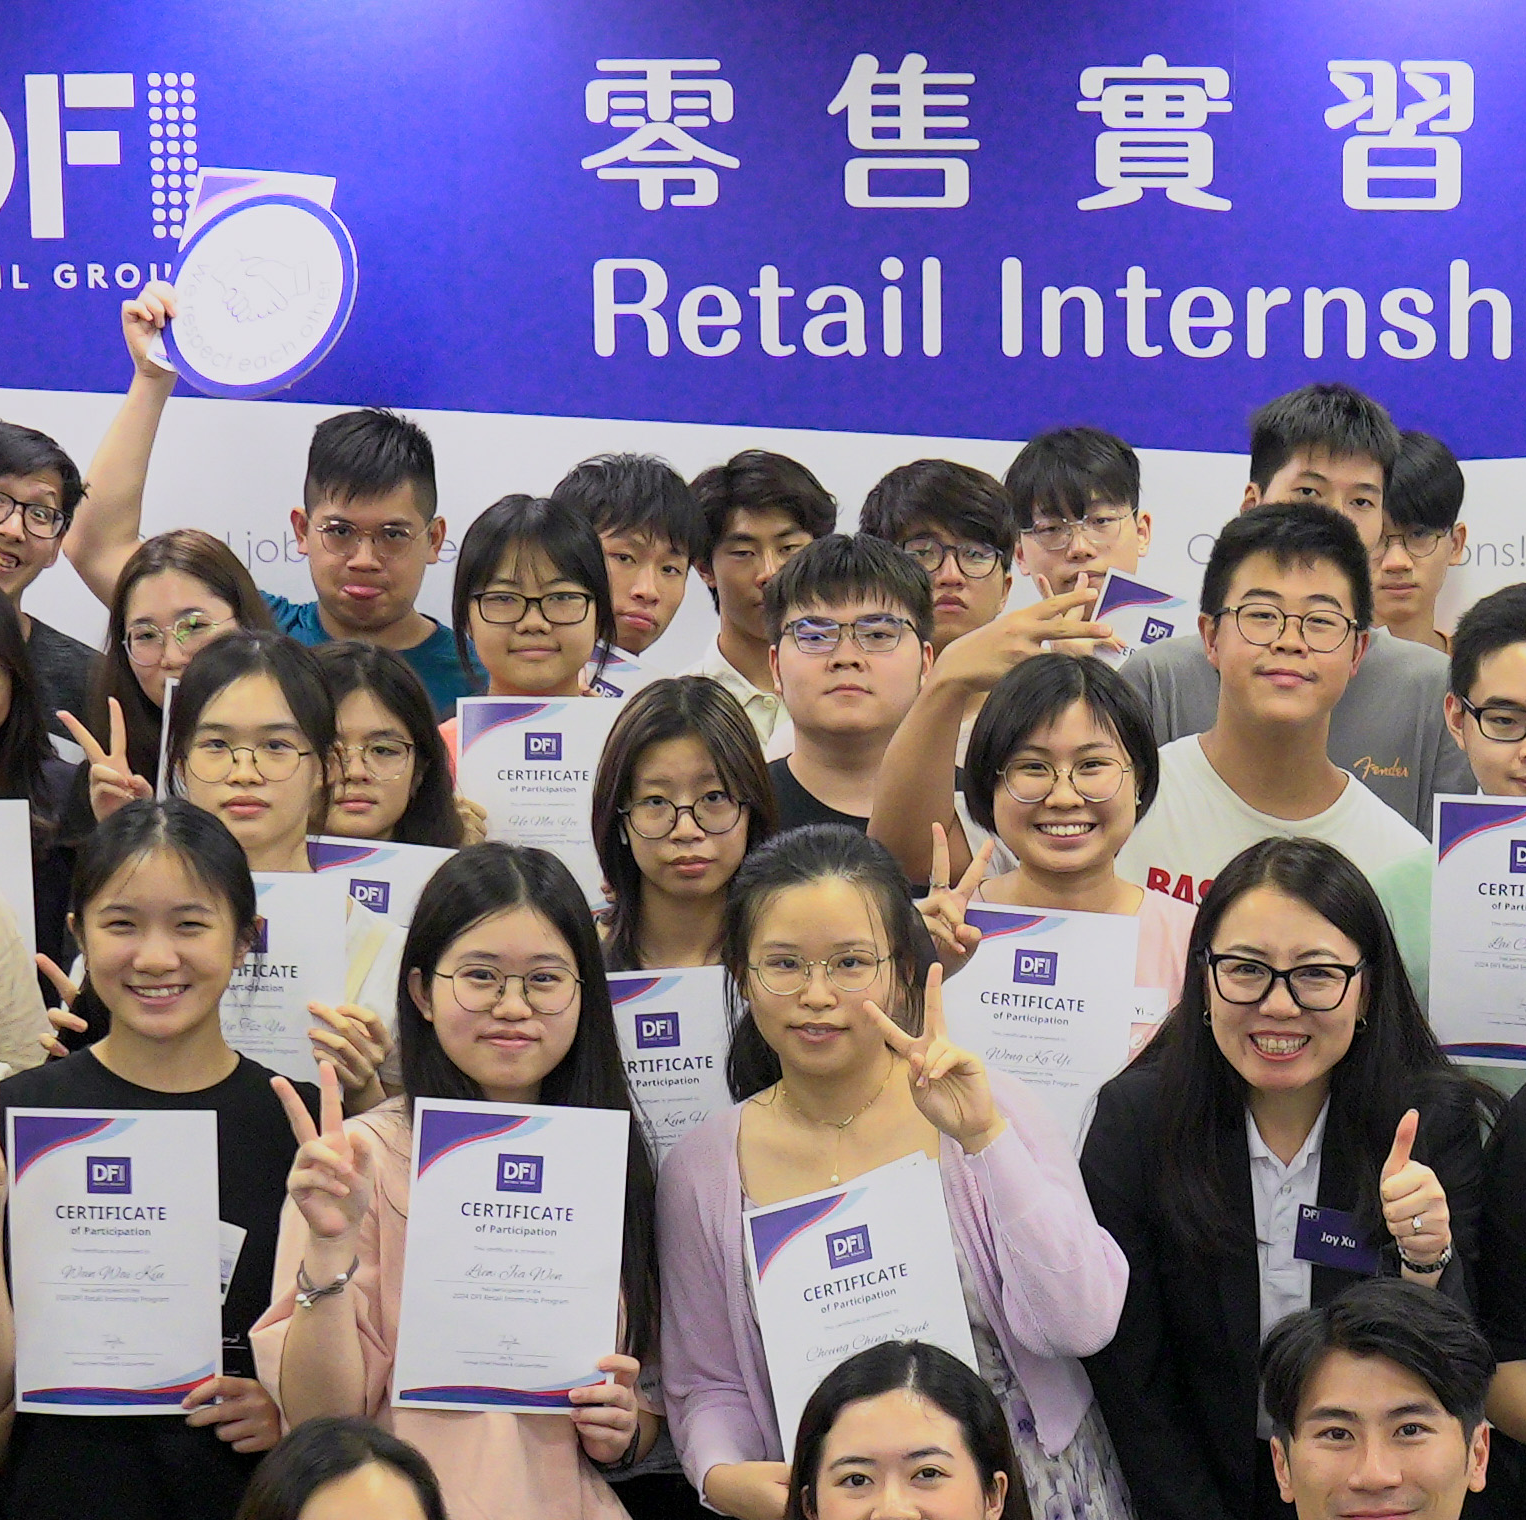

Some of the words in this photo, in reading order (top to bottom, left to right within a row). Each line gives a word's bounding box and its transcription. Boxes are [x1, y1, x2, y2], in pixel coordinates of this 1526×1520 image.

[53, 262, 172, 292] GROU
[592, 256, 942, 359] Retail
[530, 738, 557, 752] DFI
[497, 769, 589, 781] CERTIFICATE
[1354, 756, 1409, 779] Fender
[354, 885, 384, 902] DFI
[1491, 902, 1501, 910] of
[231, 963, 299, 978] IFICATE
[1020, 956, 1051, 974] DFI
[980, 991, 1085, 1012] CERTIFICATE
[993, 1012, 1003, 1020] of
[1006, 1013, 1069, 1025] Participation
[642, 1019, 674, 1037] DFI
[623, 1056, 714, 1074] RTIFICATE
[636, 1077, 700, 1089] Participation
[91, 1164, 125, 1183] DFI
[503, 1162, 537, 1180] DFI
[55, 1205, 167, 1220] CERTIFICATE
[461, 1202, 574, 1221] CERTIFICATE
[71, 1227, 81, 1235] of
[84, 1227, 152, 1237] Participation
[475, 1224, 486, 1233] of
[490, 1225, 557, 1237] Participation
[833, 1232, 865, 1257] DFI
[1321, 1232, 1339, 1246] Joy
[1341, 1236, 1355, 1248] Xu
[803, 1263, 908, 1302] CERTIFICATE
[821, 1305, 830, 1314] of
[834, 1288, 896, 1311] Participation
